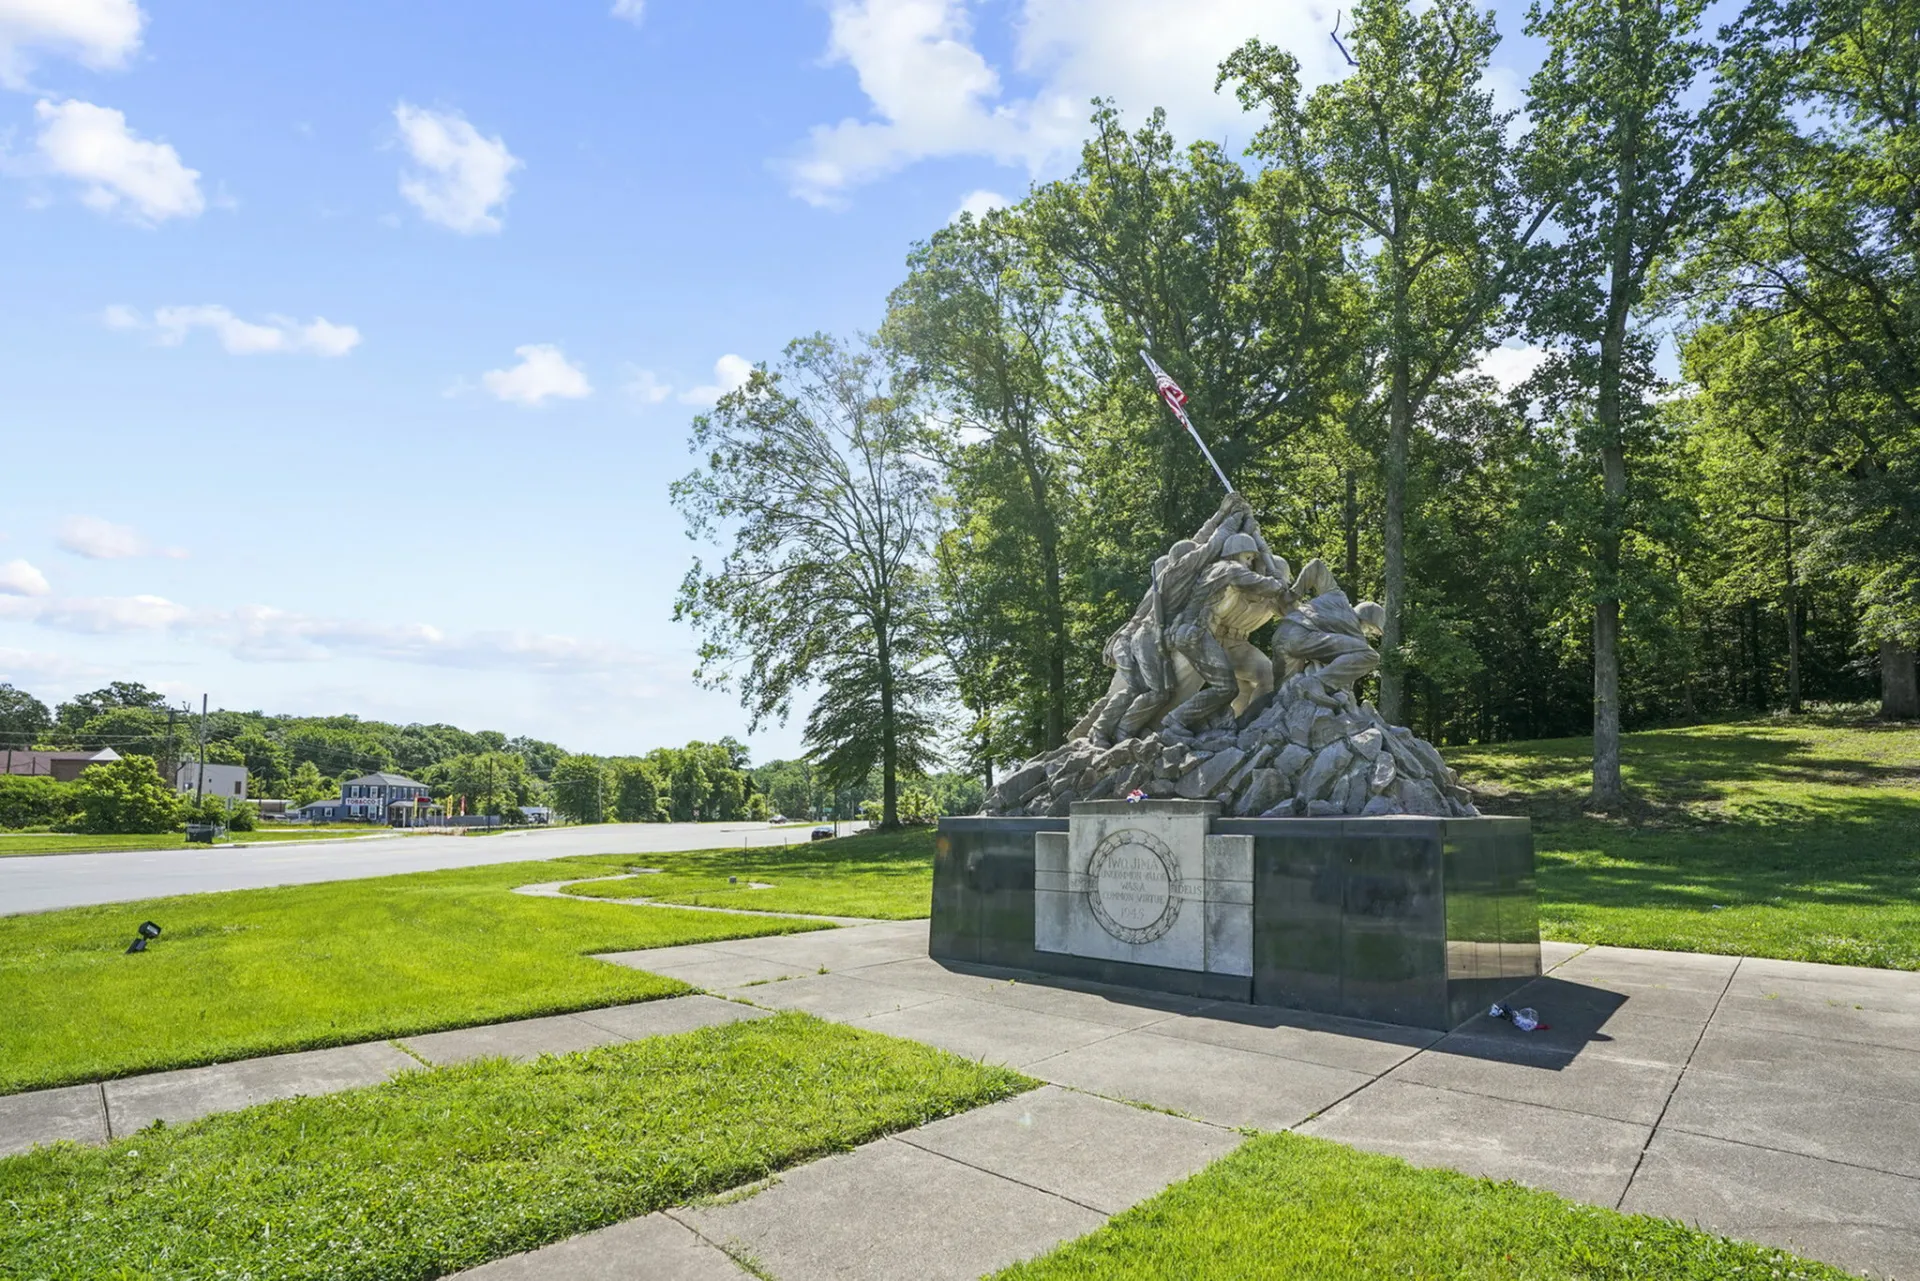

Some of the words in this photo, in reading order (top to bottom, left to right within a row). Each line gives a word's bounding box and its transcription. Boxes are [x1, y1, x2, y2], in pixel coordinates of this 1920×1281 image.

[1108, 857, 1128, 869] IWO
[1130, 857, 1158, 870] JIMA
[1120, 881, 1138, 891] WAS
[1138, 882, 1146, 892] A
[1171, 884, 1202, 895] FIDELIS
[1102, 892, 1134, 902] COMMON
[1136, 894, 1165, 904] VIRTUE
[1121, 907, 1144, 920] 1945
